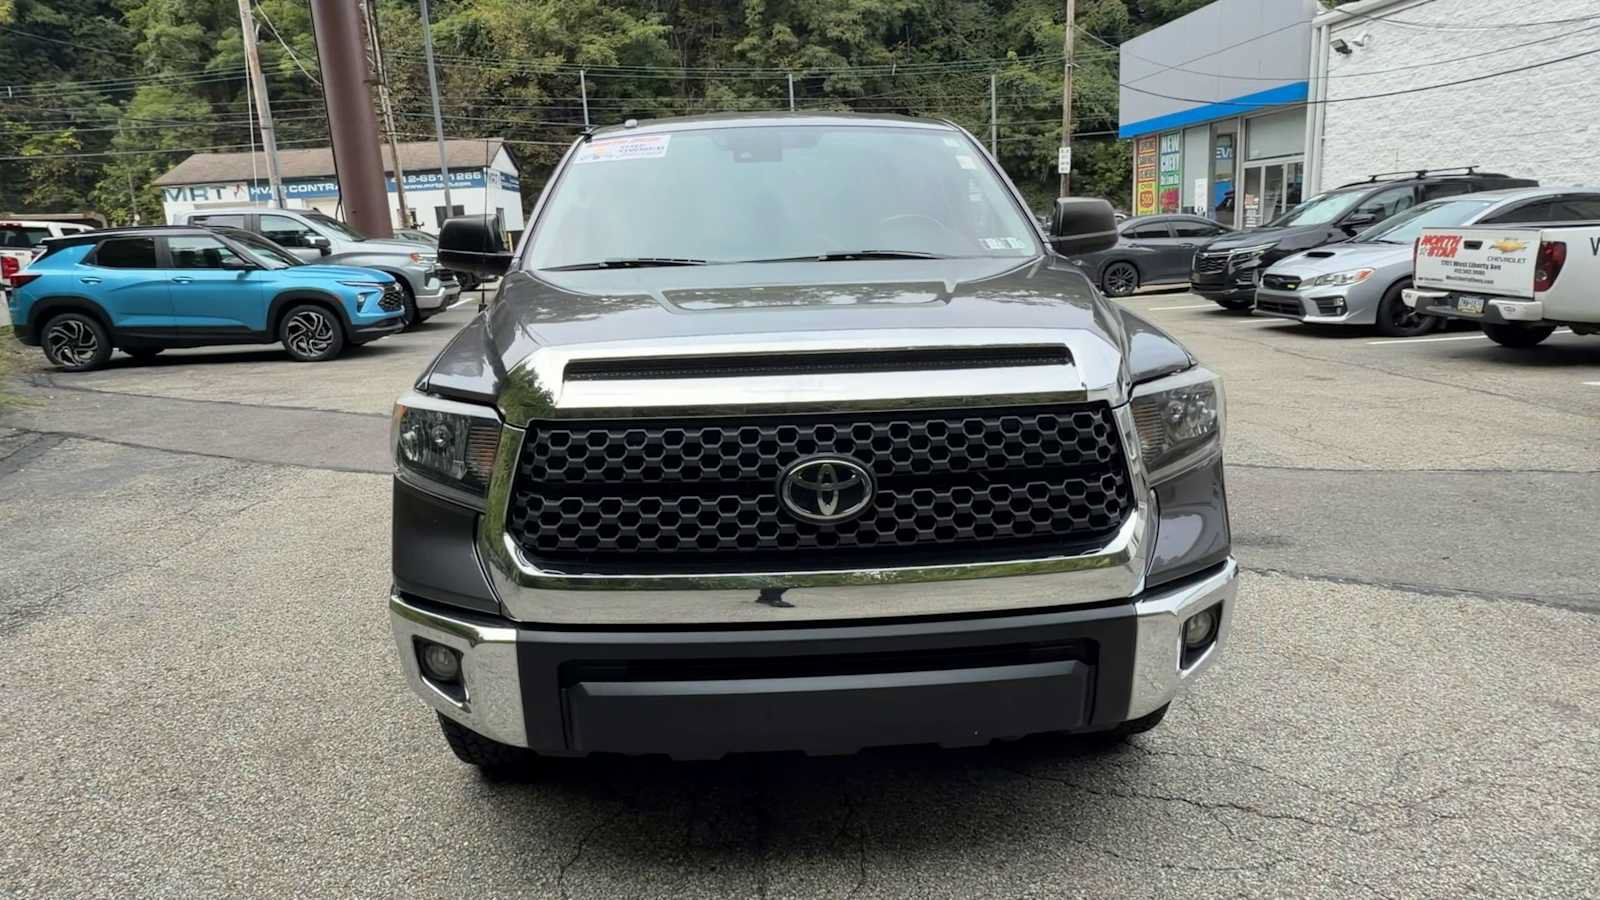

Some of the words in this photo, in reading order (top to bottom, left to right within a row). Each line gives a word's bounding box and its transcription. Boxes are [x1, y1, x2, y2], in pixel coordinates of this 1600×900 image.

[1161, 133, 1180, 152] NEW
[163, 185, 226, 202] MRT
[1420, 235, 1463, 247] NORTH
[1427, 246, 1458, 258] STAR
[1487, 255, 1527, 264] CHEVROLET
[1469, 262, 1489, 270] Liberty
